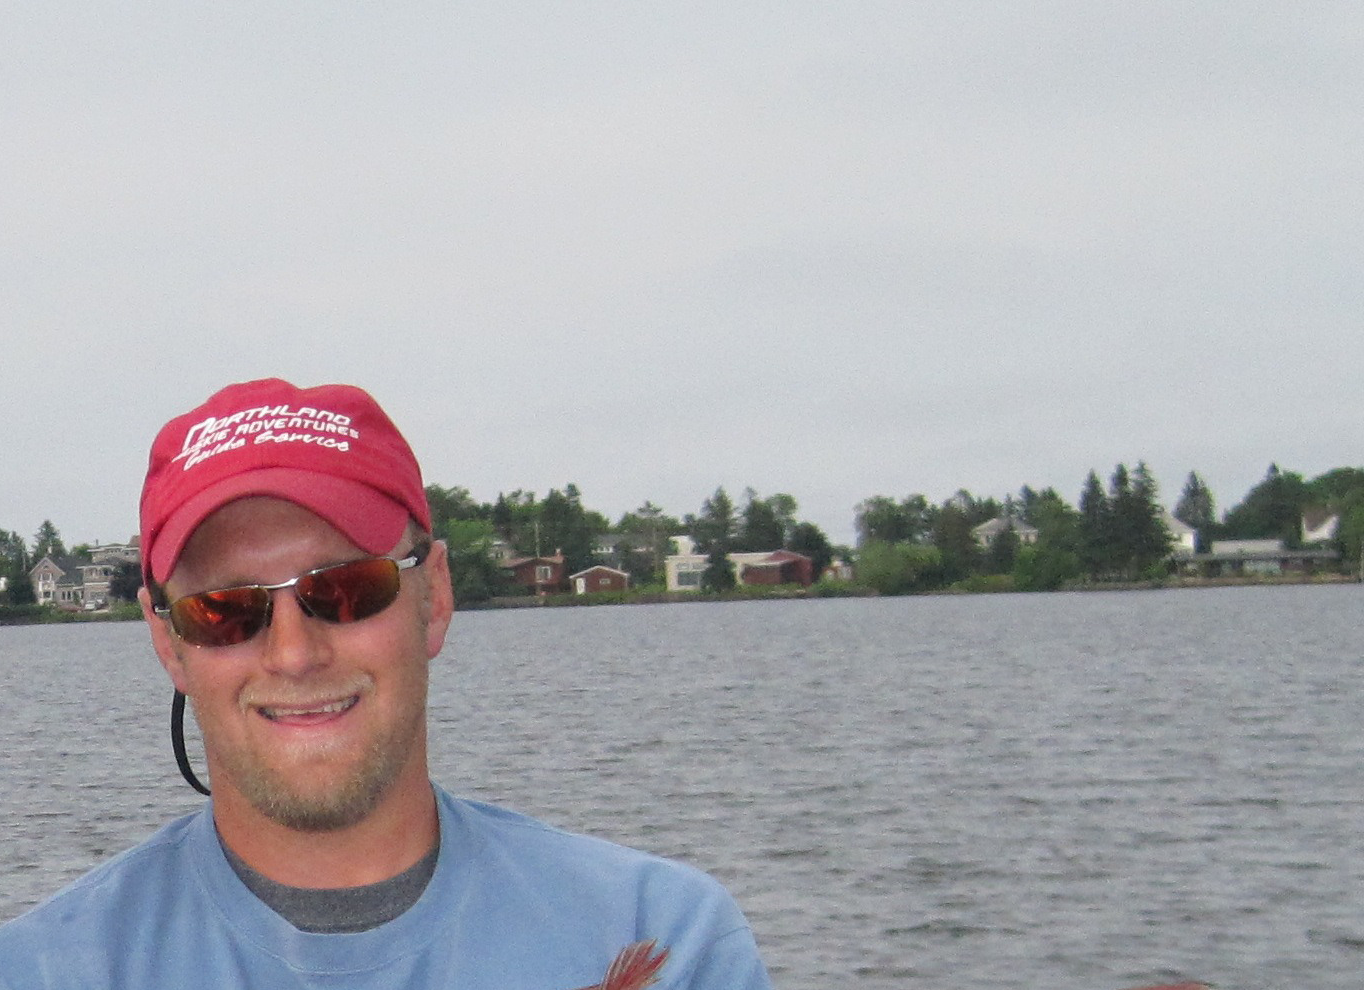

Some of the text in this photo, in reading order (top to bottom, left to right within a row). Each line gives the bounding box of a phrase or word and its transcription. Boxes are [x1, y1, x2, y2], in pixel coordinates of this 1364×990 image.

[182, 404, 352, 452] NORTHLAND
[235, 417, 360, 440] ADVENTURES
[253, 430, 350, 453] Service
